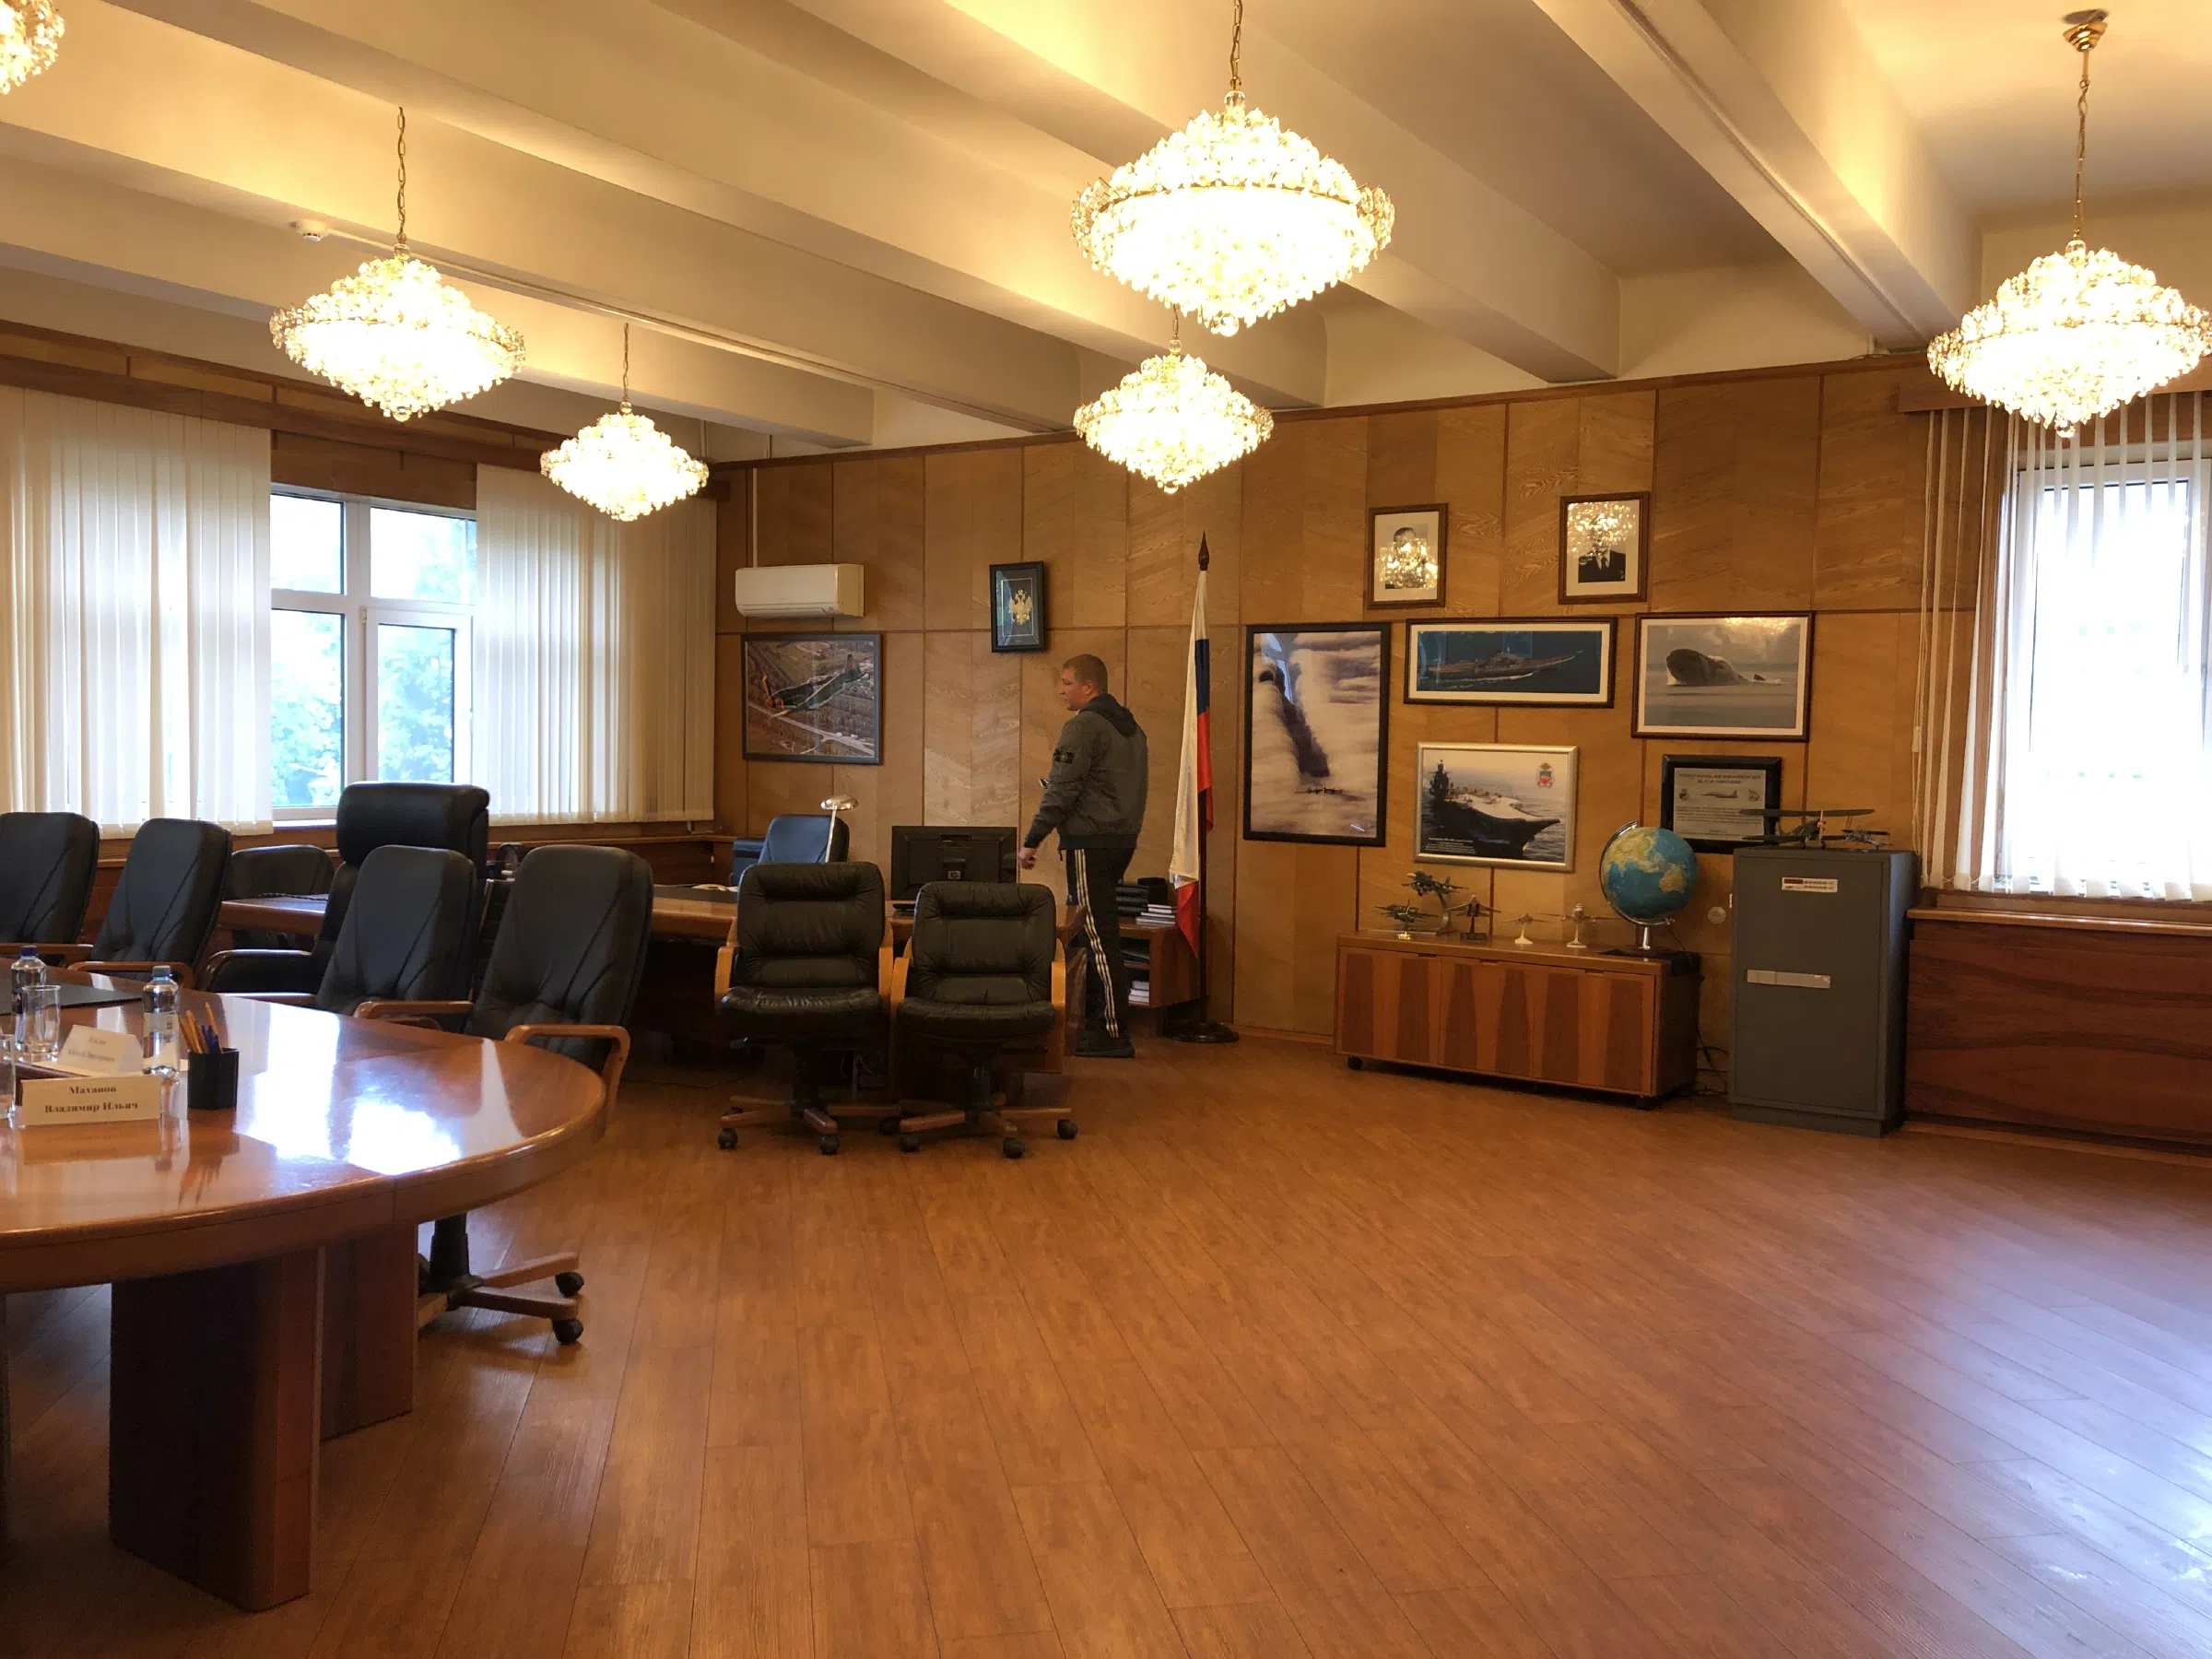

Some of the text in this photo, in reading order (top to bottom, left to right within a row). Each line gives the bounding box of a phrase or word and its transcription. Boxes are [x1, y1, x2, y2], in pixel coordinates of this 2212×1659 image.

[68, 1086, 117, 1095] Маханов
[44, 1101, 138, 1114] Владимир Ильич
